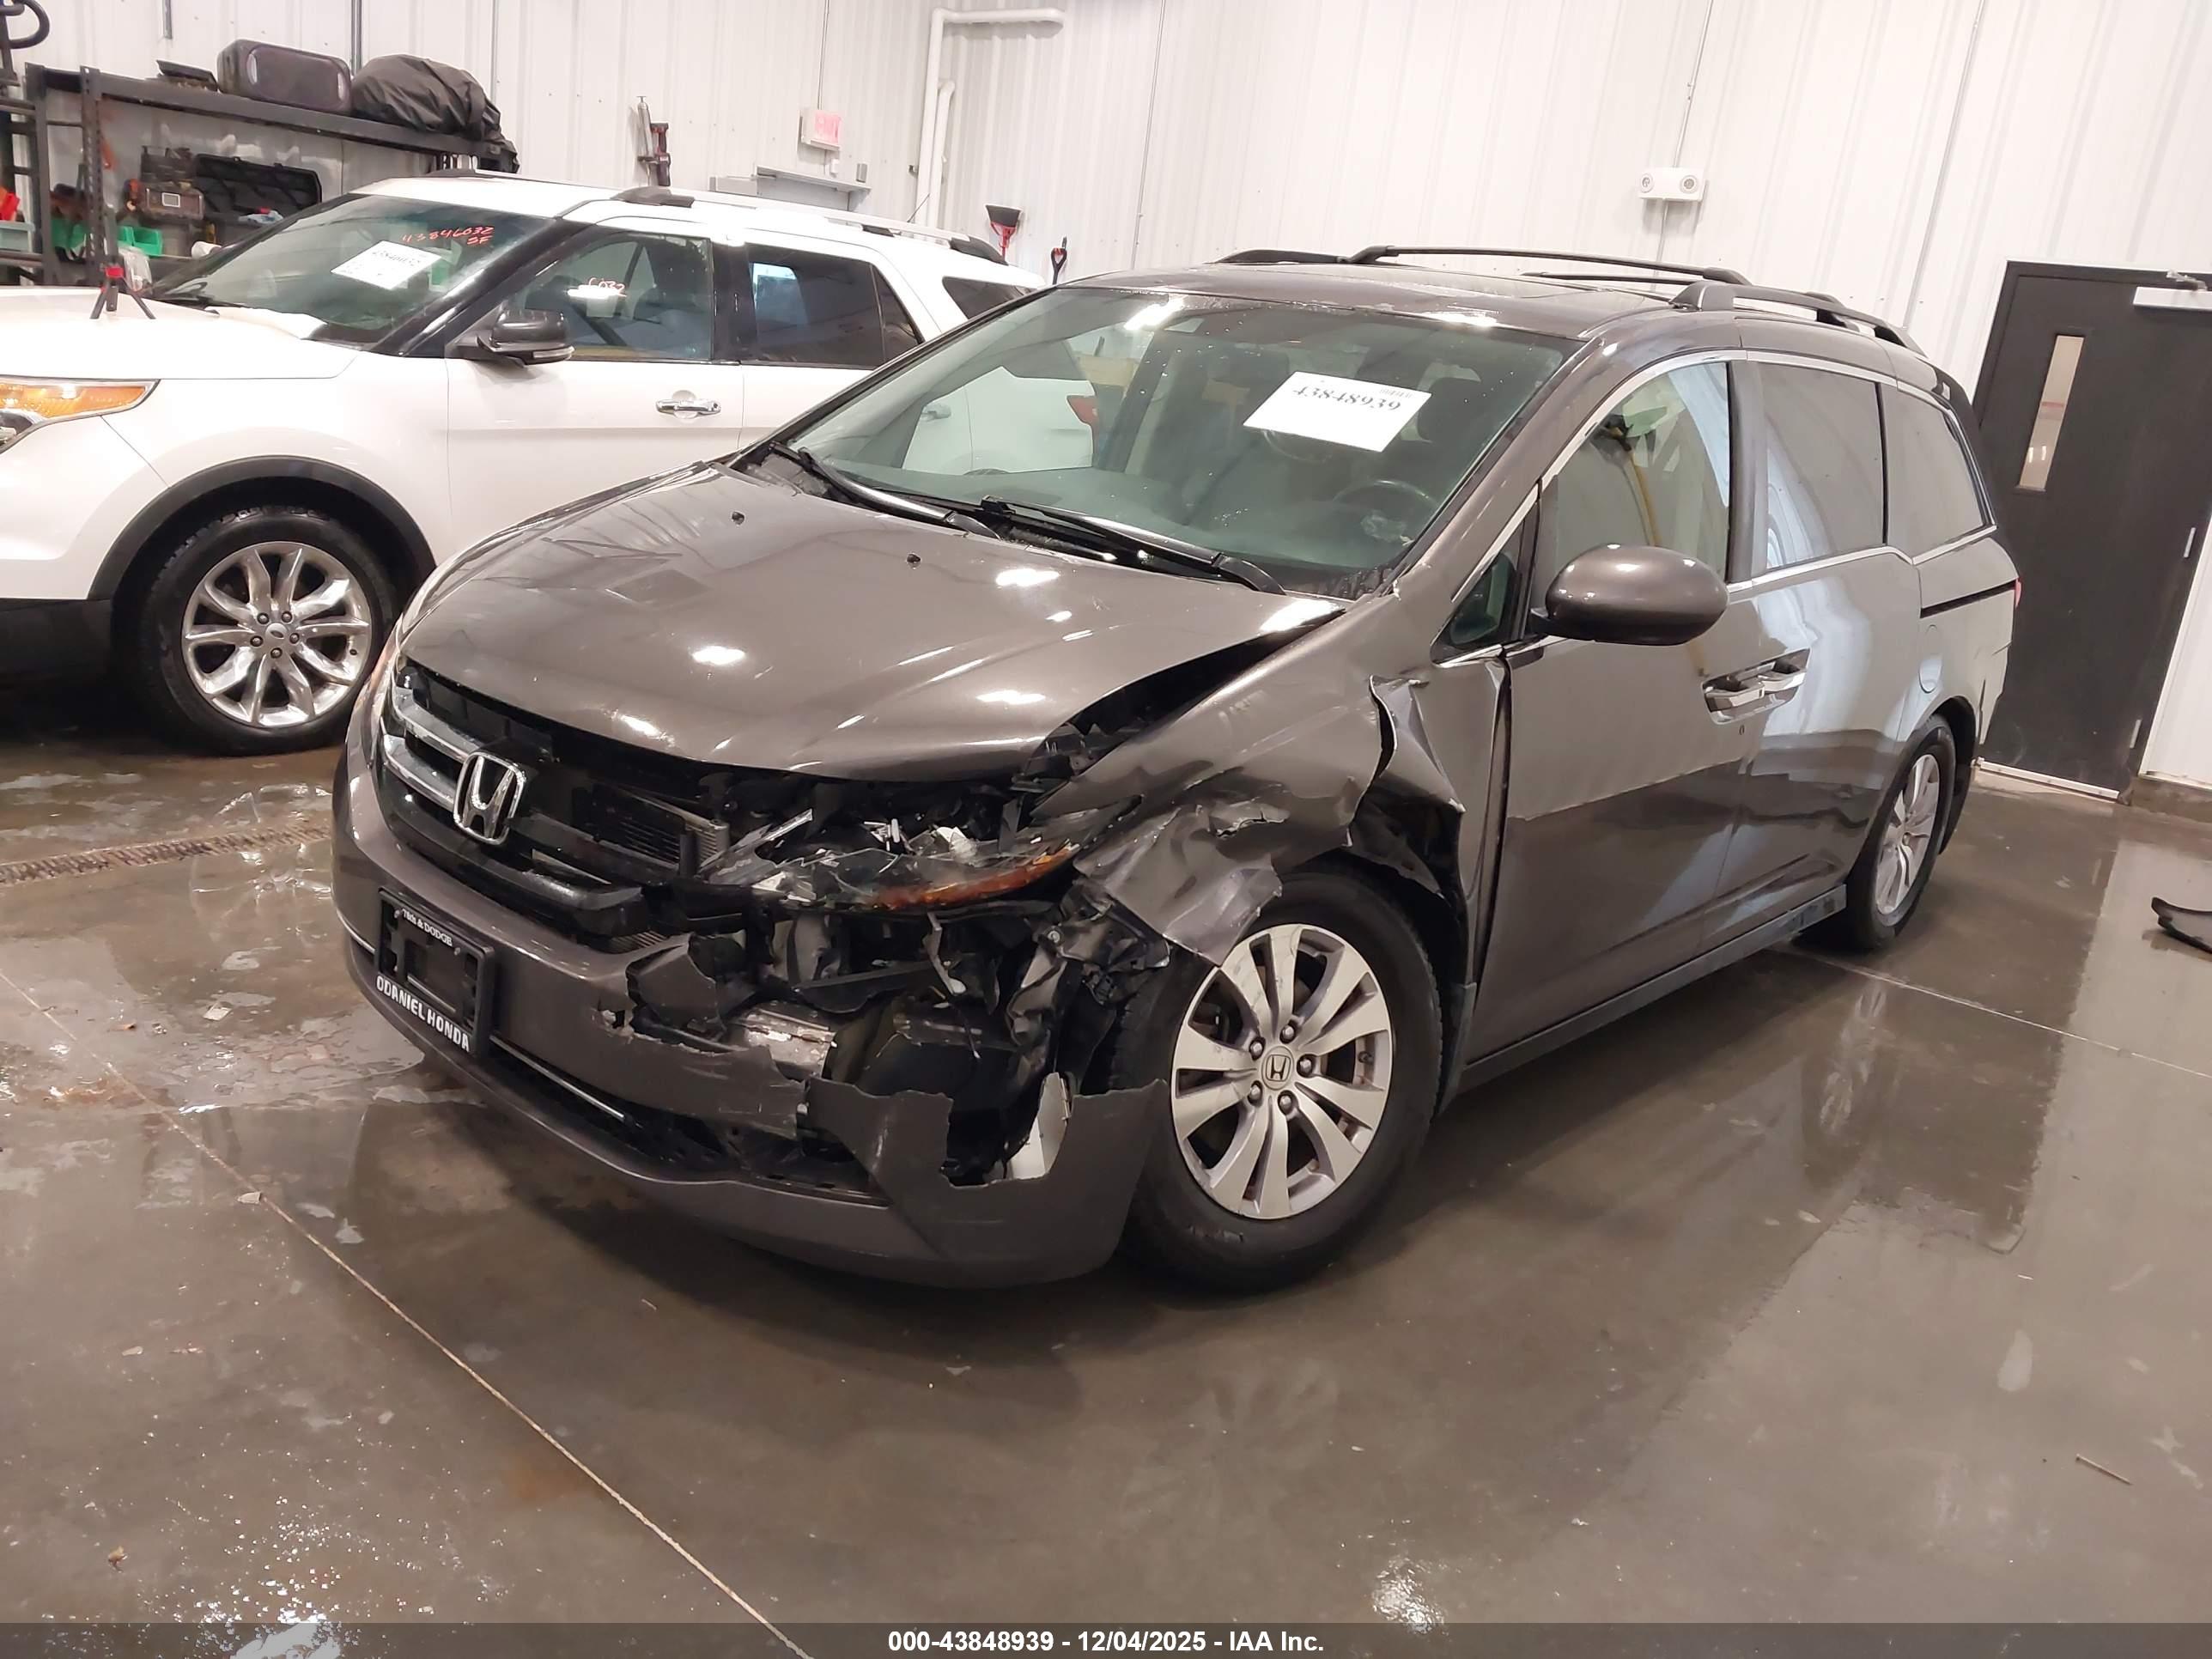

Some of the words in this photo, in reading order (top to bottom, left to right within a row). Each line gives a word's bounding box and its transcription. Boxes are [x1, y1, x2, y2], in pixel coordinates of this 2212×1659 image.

[1292, 386, 1401, 411] 43848939
[416, 918, 424, 929] &
[423, 921, 453, 947] DODGE
[376, 975, 426, 1021] ODANIEL
[427, 1008, 470, 1053] HONDA
